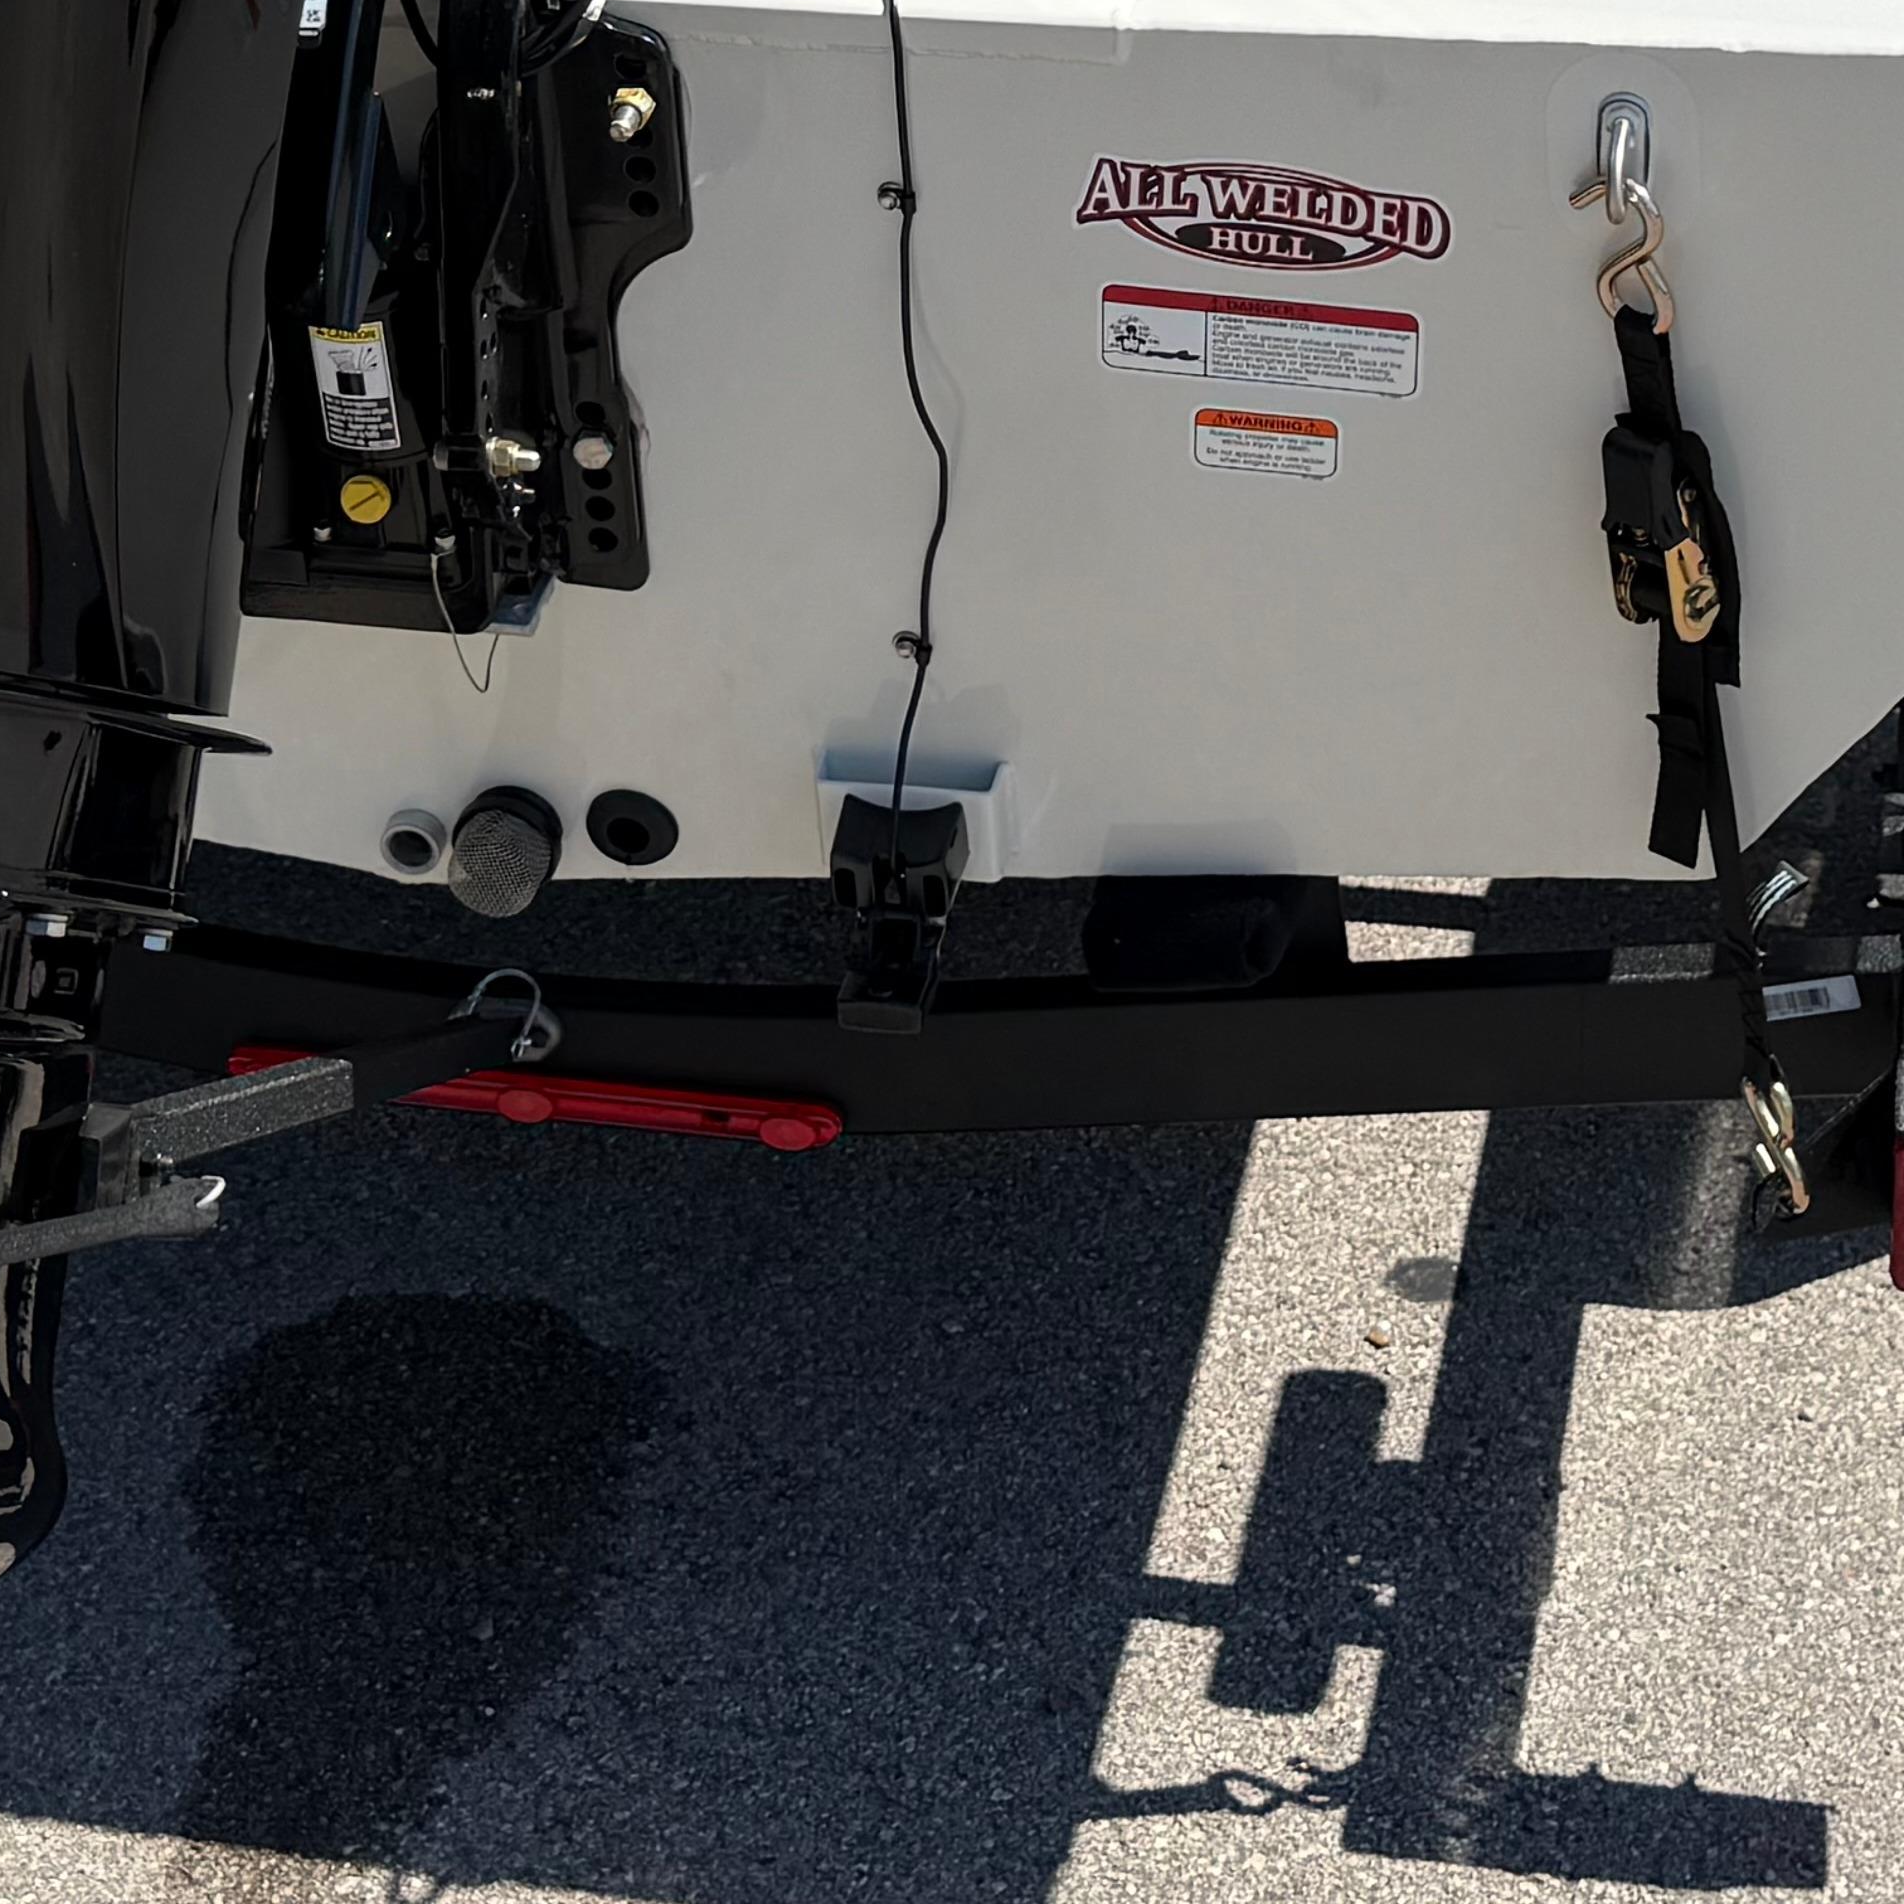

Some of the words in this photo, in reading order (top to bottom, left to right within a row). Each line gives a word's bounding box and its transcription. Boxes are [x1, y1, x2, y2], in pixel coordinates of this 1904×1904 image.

[1076, 158, 1197, 224] ALL
[1200, 172, 1450, 260] WELDED
[1210, 227, 1313, 261] HULL
[1226, 299, 1294, 317] DANGER
[1228, 414, 1302, 431] WARNING
